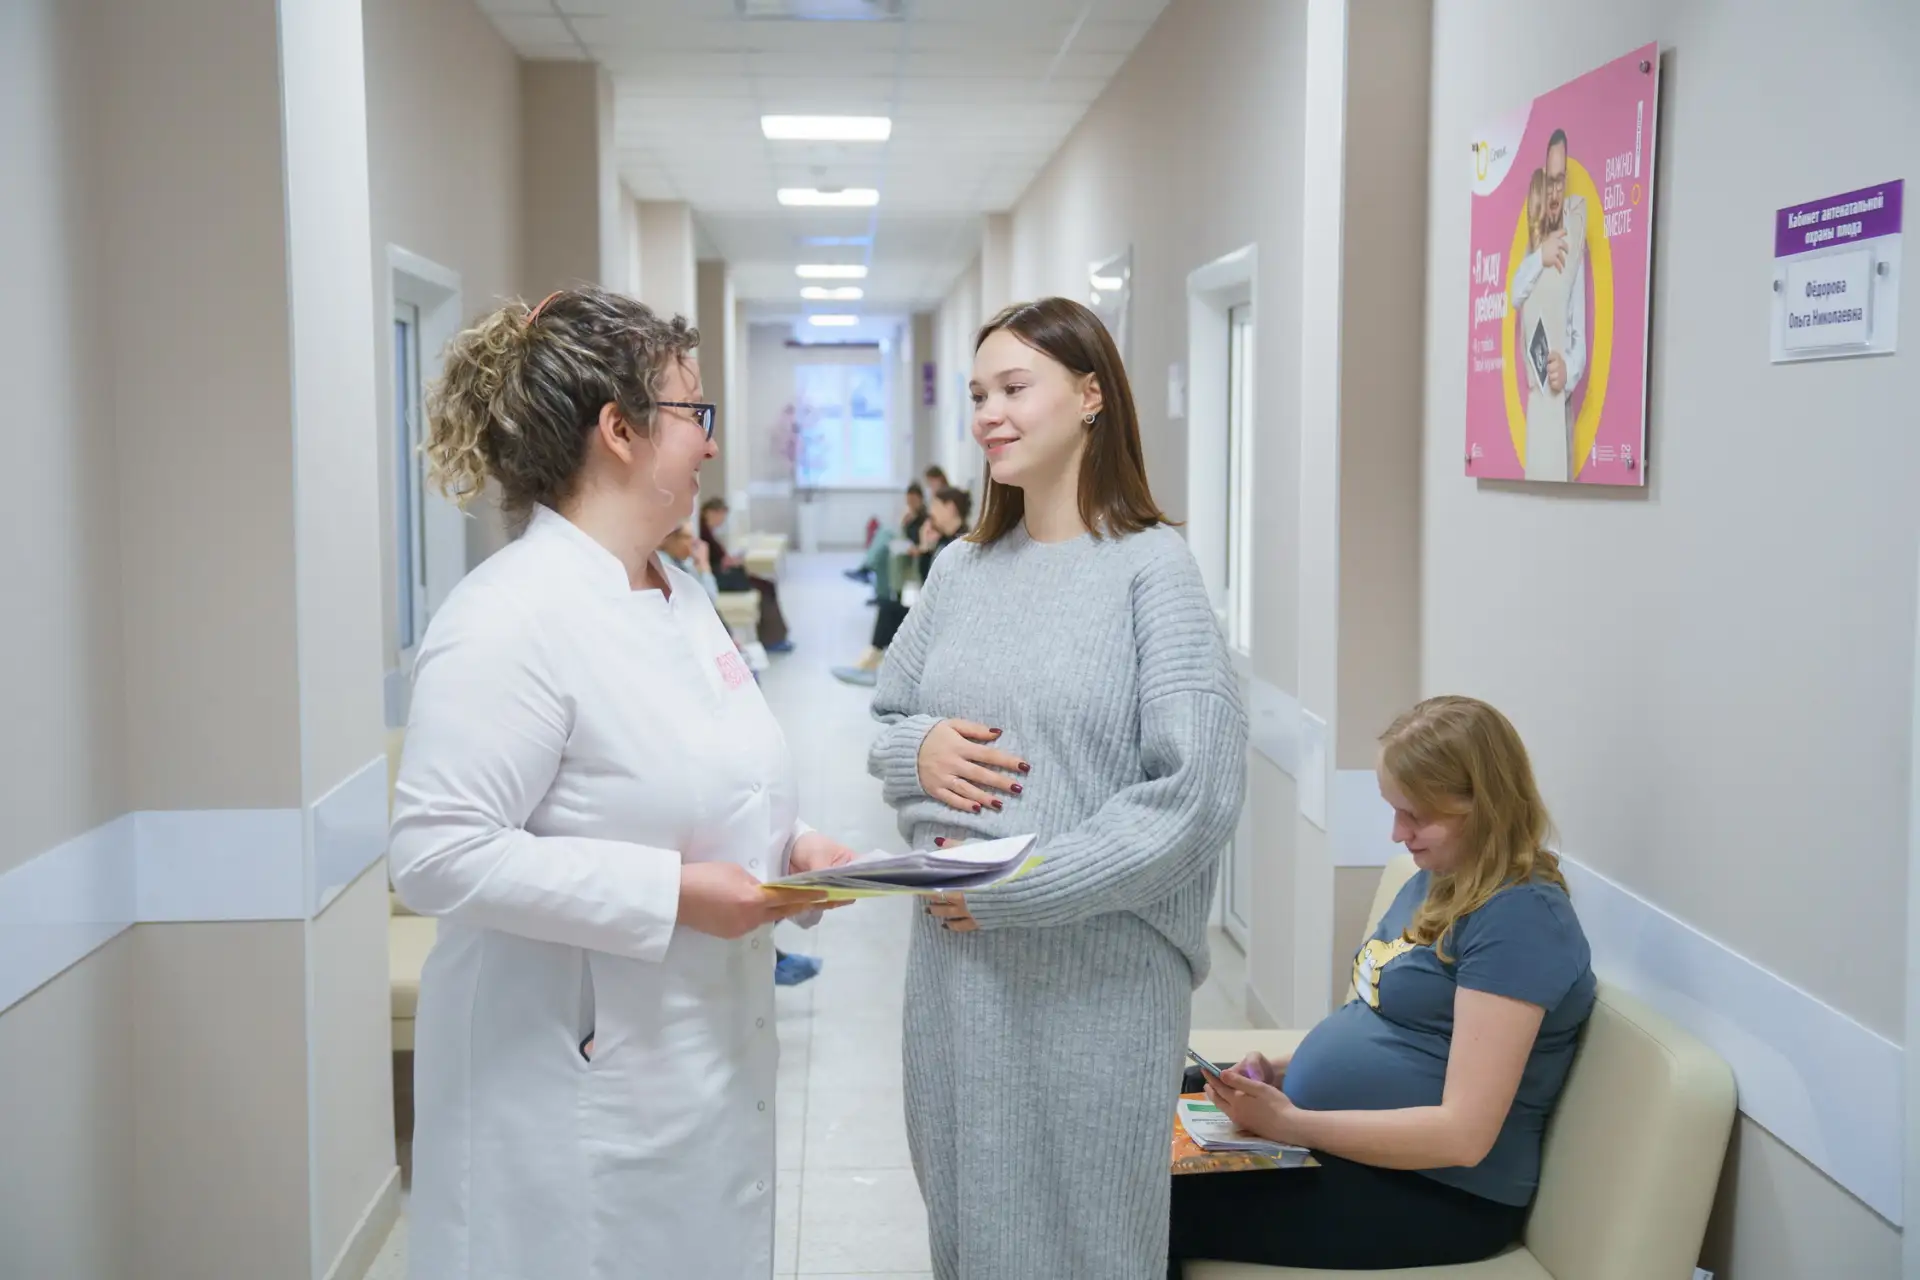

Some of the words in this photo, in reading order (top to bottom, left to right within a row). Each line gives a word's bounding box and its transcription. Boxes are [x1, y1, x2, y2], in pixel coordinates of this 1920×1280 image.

[1605, 151, 1633, 183] ВАЖНО
[1604, 184, 1625, 211] БЫТЬ
[1788, 210, 1820, 229] Кабинет
[1821, 191, 1884, 221] антенатальной
[1603, 209, 1633, 238] ВМЕСТЕ
[1805, 227, 1835, 246] охраны
[1837, 220, 1862, 238] плода
[1482, 252, 1501, 287] жду
[1806, 279, 1846, 301] Фёдорова
[1789, 312, 1811, 329] Ольга
[1812, 307, 1862, 326] Николаевна
